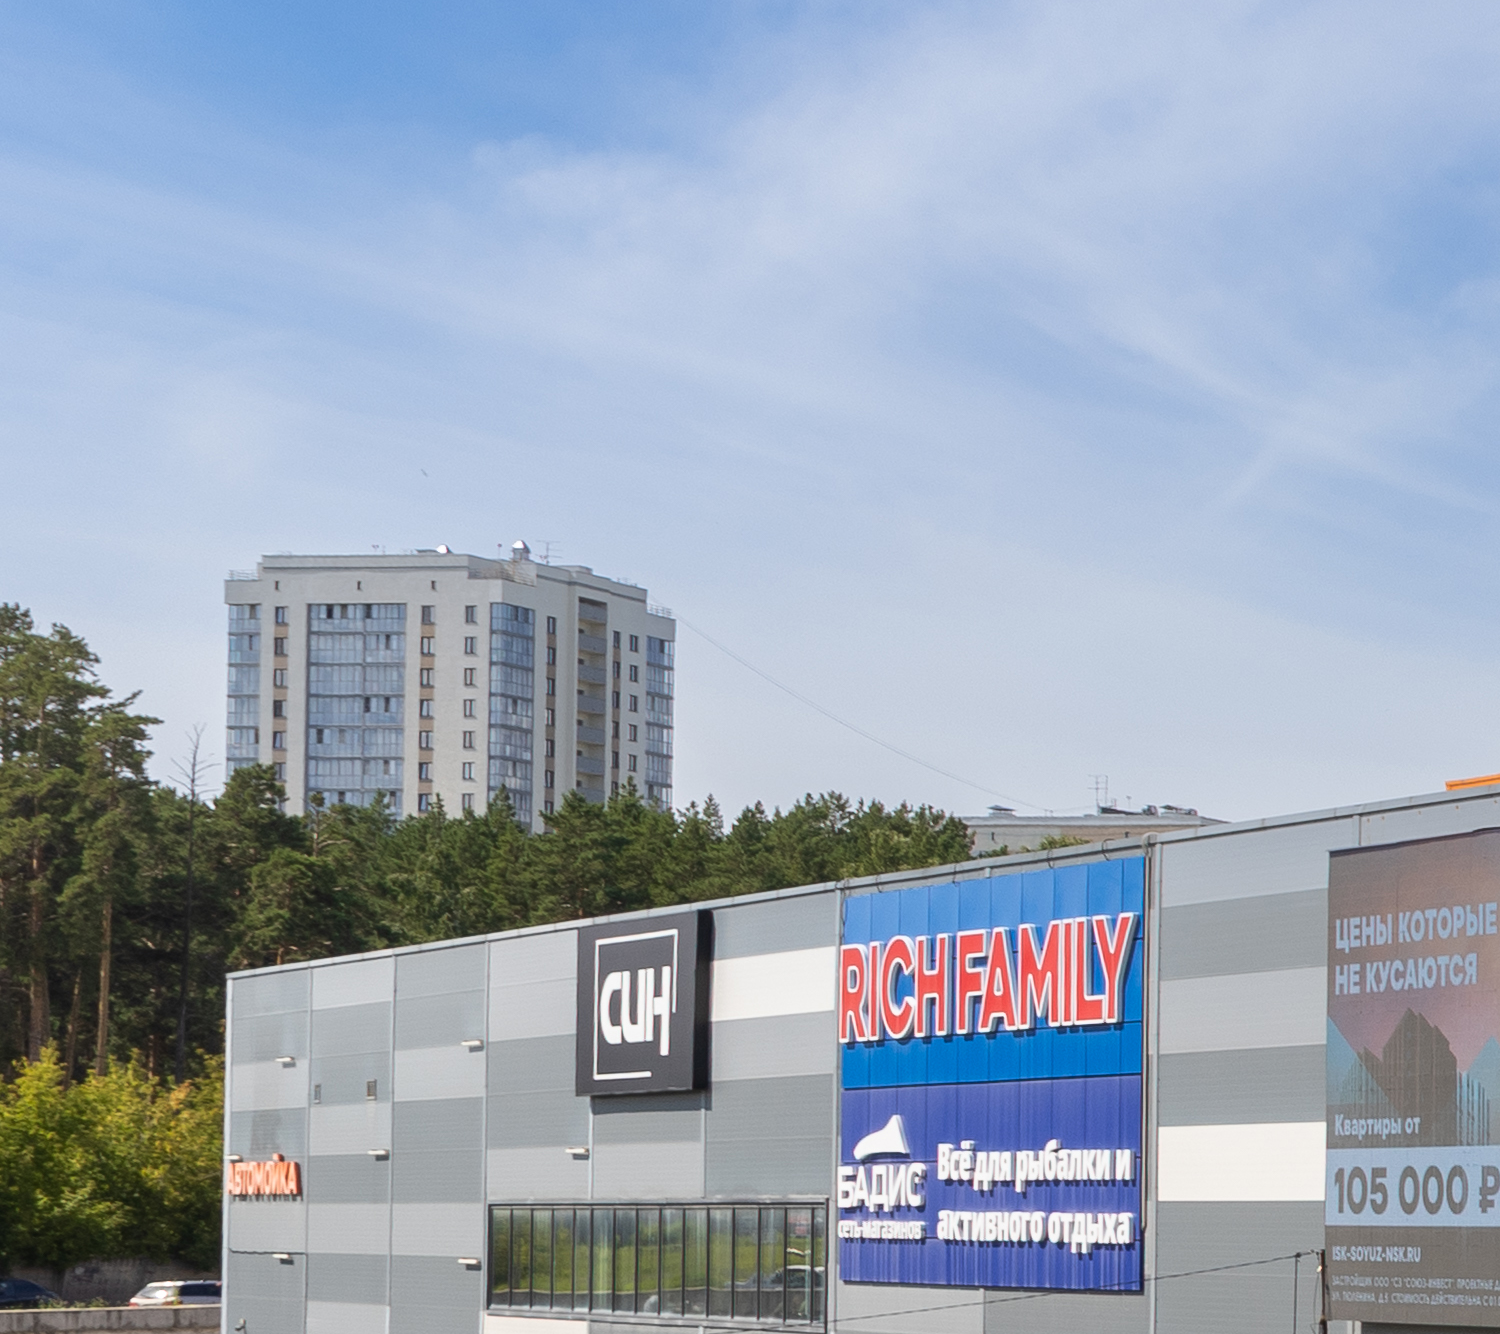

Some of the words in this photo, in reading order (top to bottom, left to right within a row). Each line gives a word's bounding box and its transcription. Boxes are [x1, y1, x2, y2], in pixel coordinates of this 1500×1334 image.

[1335, 914, 1393, 953] ЦЕНЫ
[1397, 902, 1498, 947] КОТОРЫЕ
[839, 933, 949, 1044] RICH
[957, 912, 1139, 1035] FAMILY
[1335, 964, 1361, 995] НЕ
[1365, 953, 1479, 993] КУСАЮТСЯ
[1335, 1114, 1402, 1140] Квартиры
[1404, 1117, 1421, 1135] от
[837, 1162, 928, 1213] БАДИС
[937, 1140, 974, 1181] Всё
[972, 1151, 1012, 1192] для
[1015, 1139, 1111, 1194] рыбалки
[1115, 1150, 1134, 1181] и
[1334, 1166, 1389, 1215] 105
[1398, 1164, 1469, 1215] 000
[937, 1210, 1045, 1243] активного
[1048, 1212, 1135, 1254] отдыха
[1331, 1244, 1422, 1264] ISK-SOYUZ-NSK.RU
